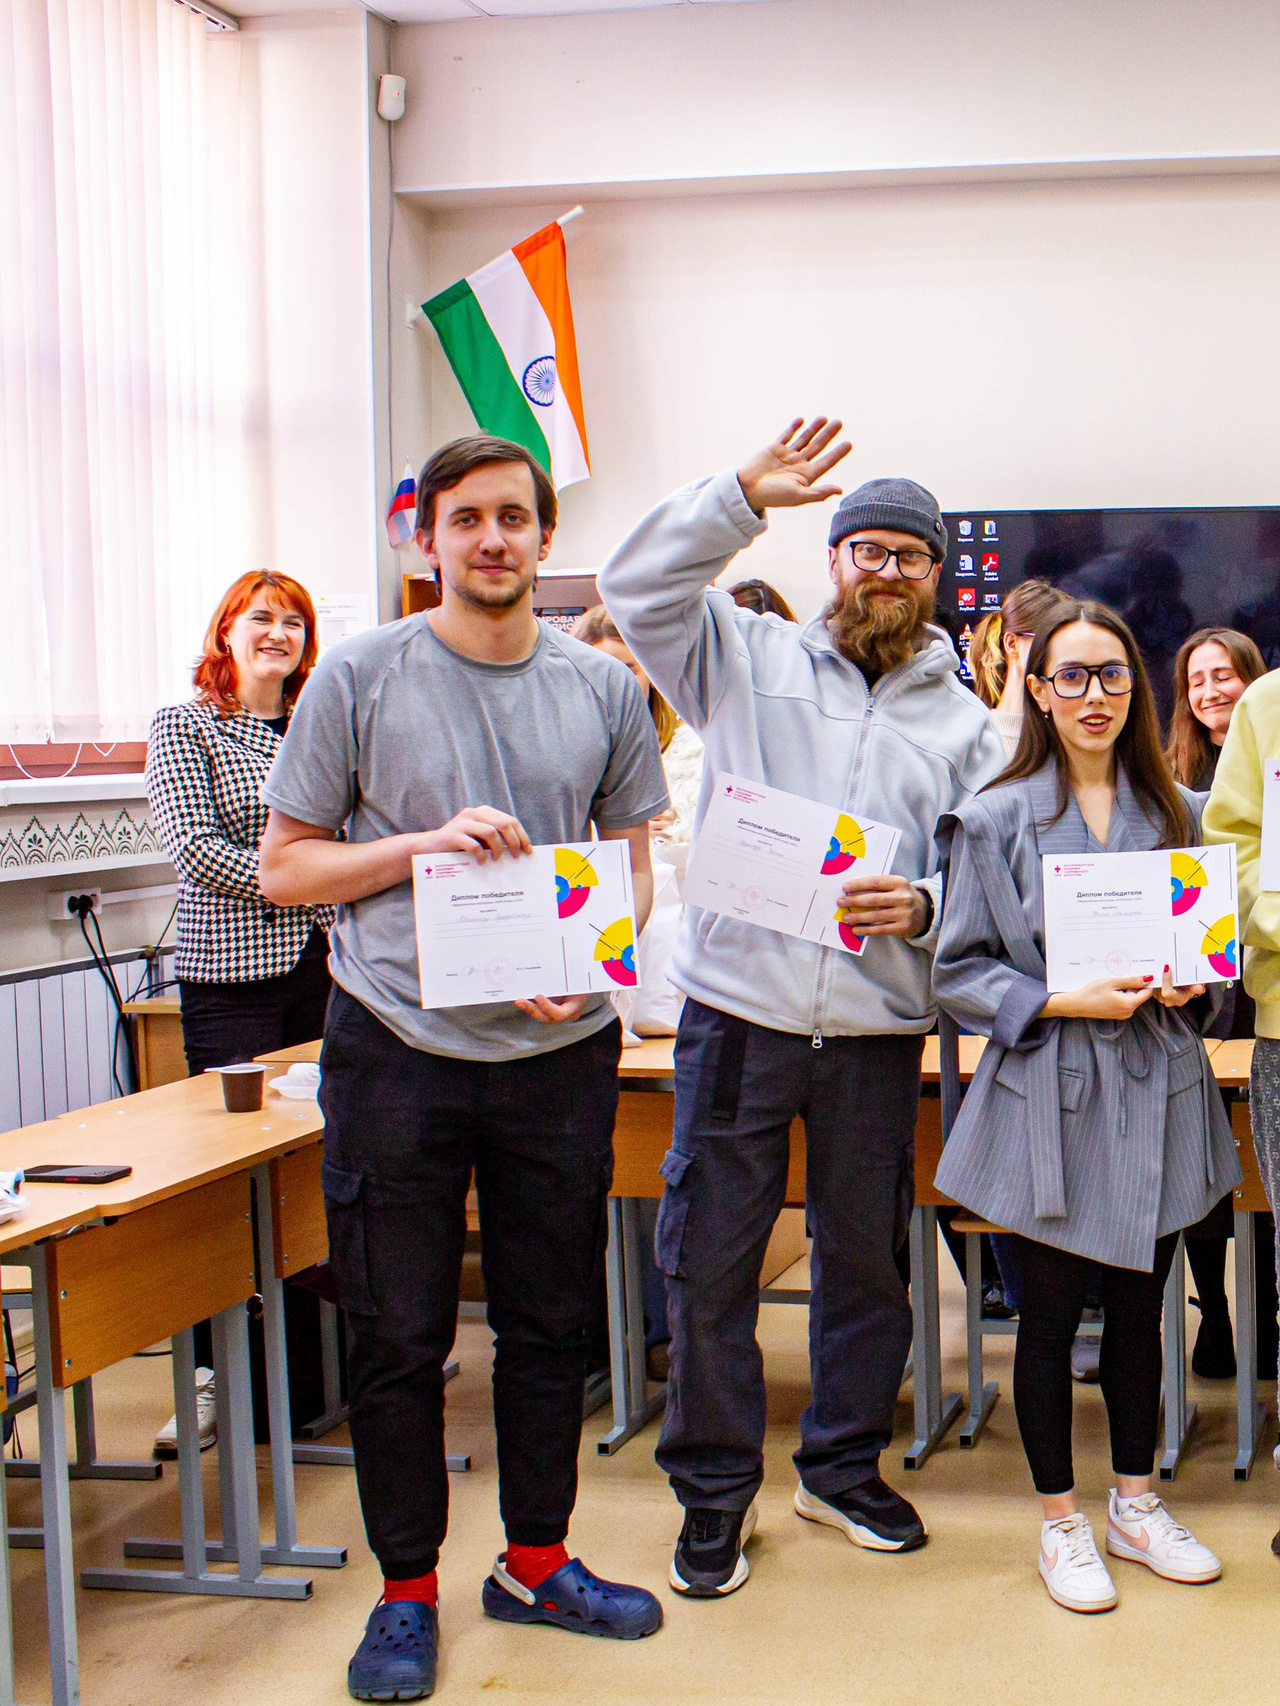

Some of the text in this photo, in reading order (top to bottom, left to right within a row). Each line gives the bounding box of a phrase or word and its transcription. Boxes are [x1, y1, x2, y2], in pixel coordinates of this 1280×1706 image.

[737, 818, 801, 842] Диплом победителя
[451, 890, 524, 902] Диплом победителя
[1076, 889, 1143, 899] Диплом победителя
